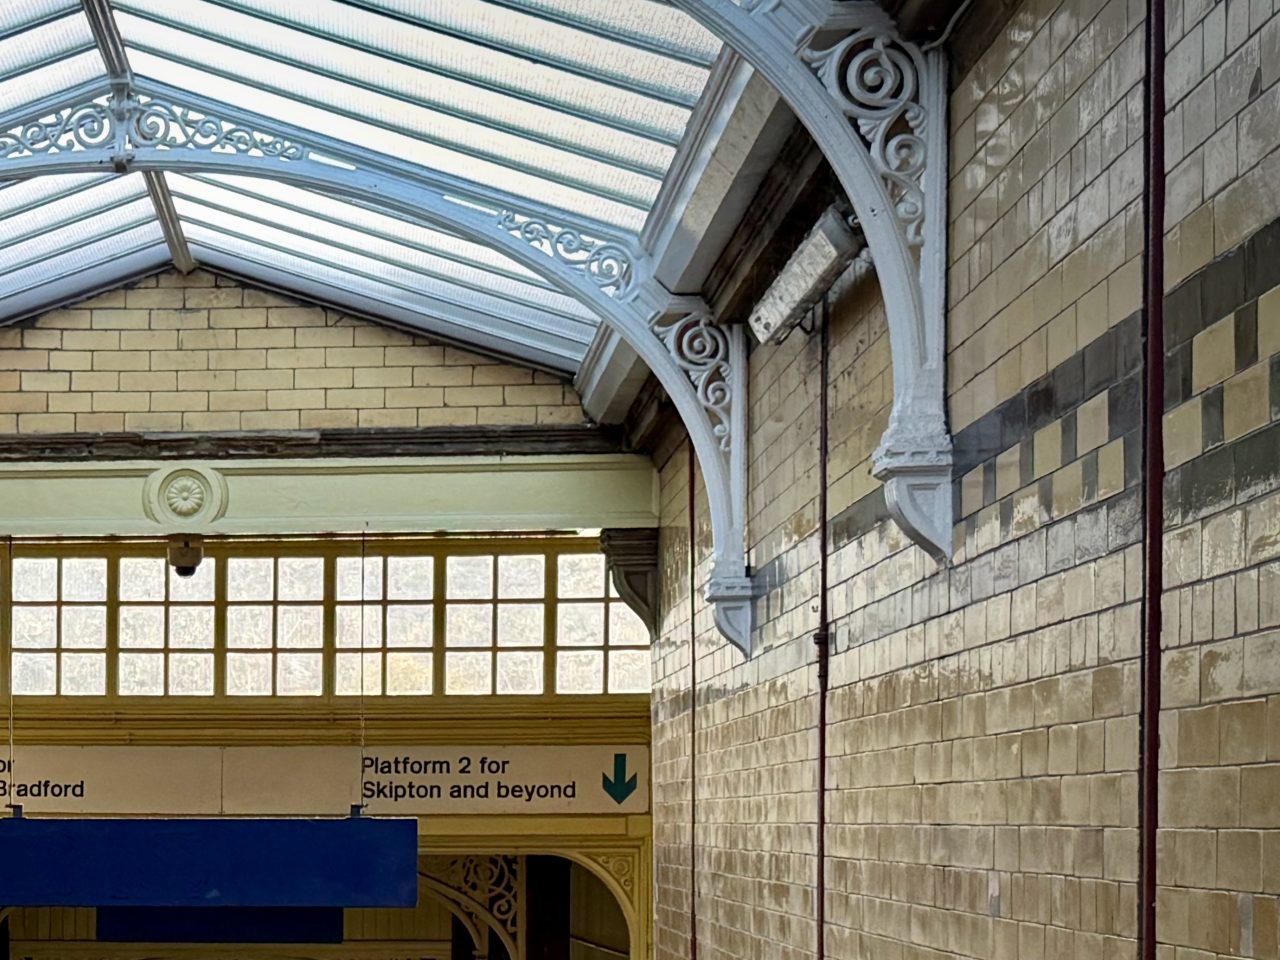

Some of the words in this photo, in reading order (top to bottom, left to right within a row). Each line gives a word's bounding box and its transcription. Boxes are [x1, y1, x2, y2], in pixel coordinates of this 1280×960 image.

[362, 756, 451, 774] Platform
[458, 757, 471, 774] 2
[480, 756, 509, 774] for
[362, 781, 442, 801] Skipton
[449, 781, 489, 798] and
[497, 781, 576, 801] beyond
